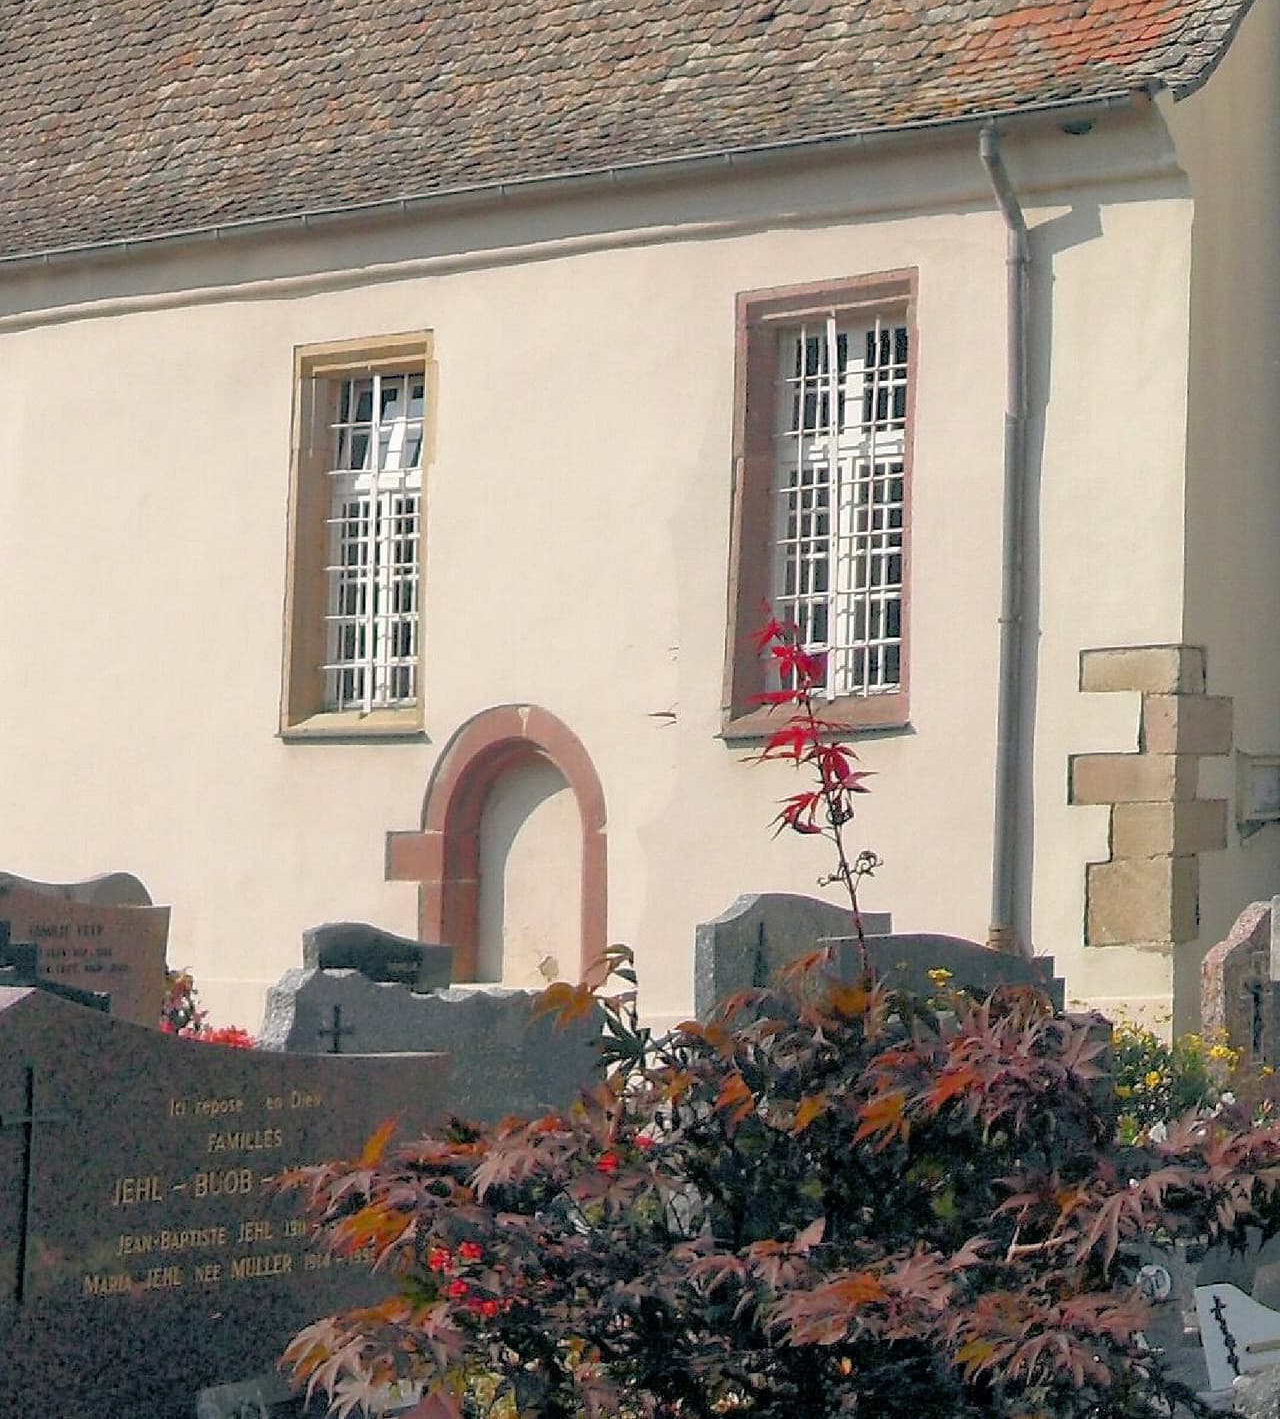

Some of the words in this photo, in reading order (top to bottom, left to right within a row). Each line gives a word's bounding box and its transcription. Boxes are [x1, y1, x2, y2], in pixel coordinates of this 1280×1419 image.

[208, 1128, 283, 1153] FAMILLES
[112, 1176, 163, 1207] JEHL
[237, 1220, 273, 1244] JEHL
[83, 1271, 133, 1296] MARIA
[143, 1266, 182, 1290] JEHL
